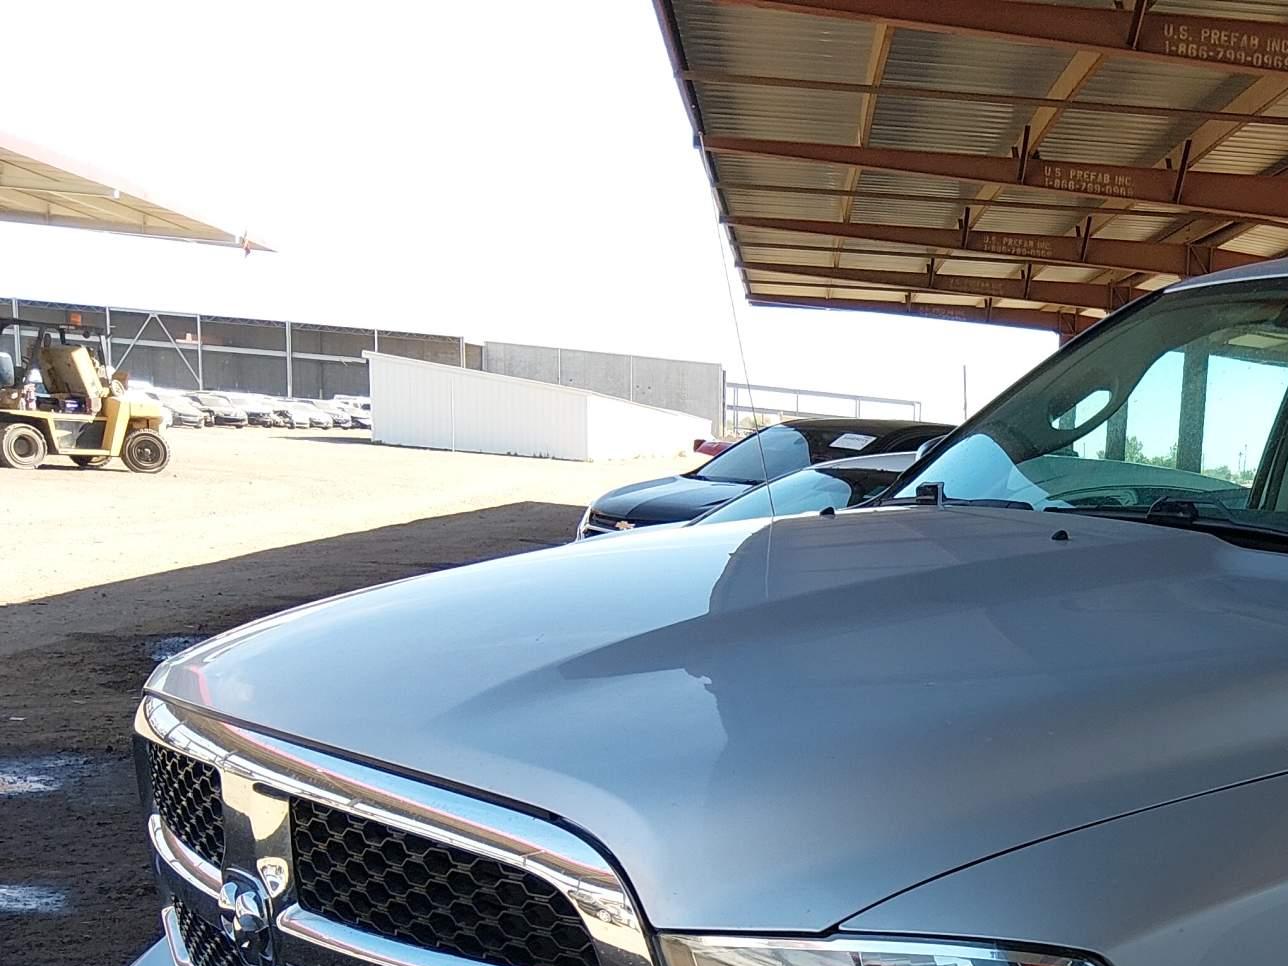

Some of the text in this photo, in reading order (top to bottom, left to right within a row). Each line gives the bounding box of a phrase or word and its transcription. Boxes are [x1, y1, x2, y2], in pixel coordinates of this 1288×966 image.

[1164, 23, 1192, 41] U.S.
[1201, 28, 1259, 50] PREFAB
[1070, 168, 1111, 184] PREFAB
